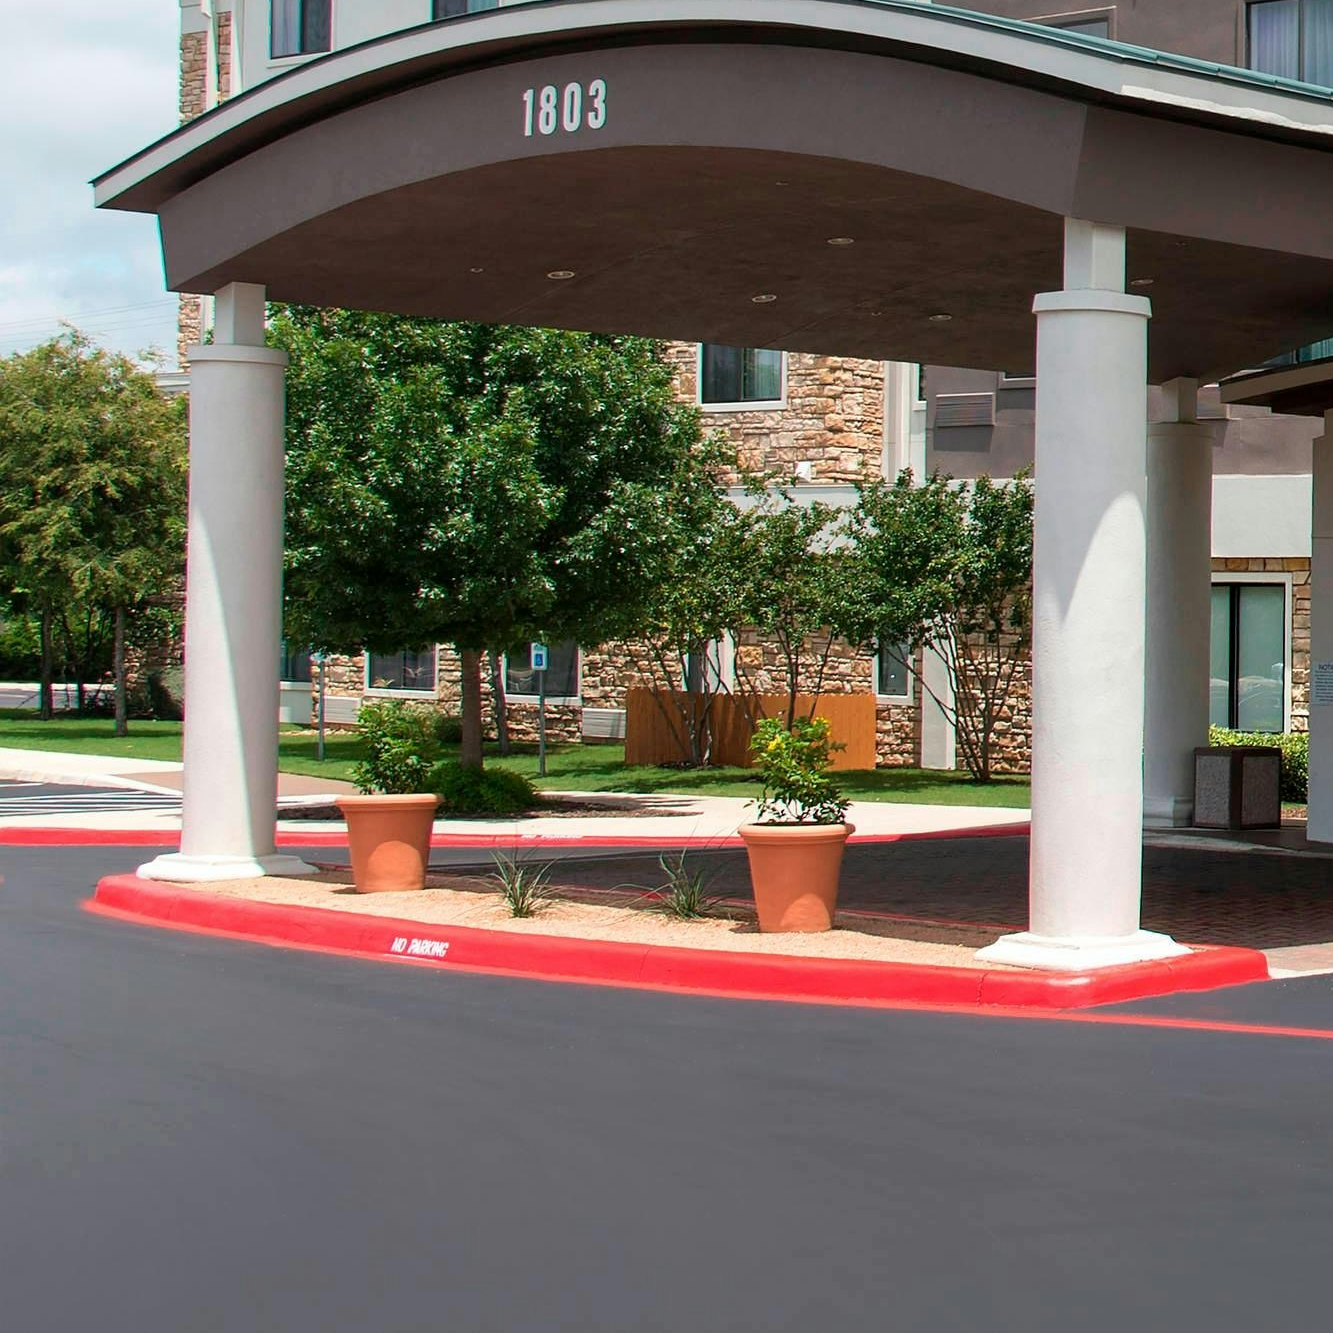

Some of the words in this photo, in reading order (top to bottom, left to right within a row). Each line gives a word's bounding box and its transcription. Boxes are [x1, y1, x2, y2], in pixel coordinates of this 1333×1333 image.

[523, 78, 607, 137] 1803
[391, 937, 407, 953] NO
[408, 938, 449, 957] PARKING
